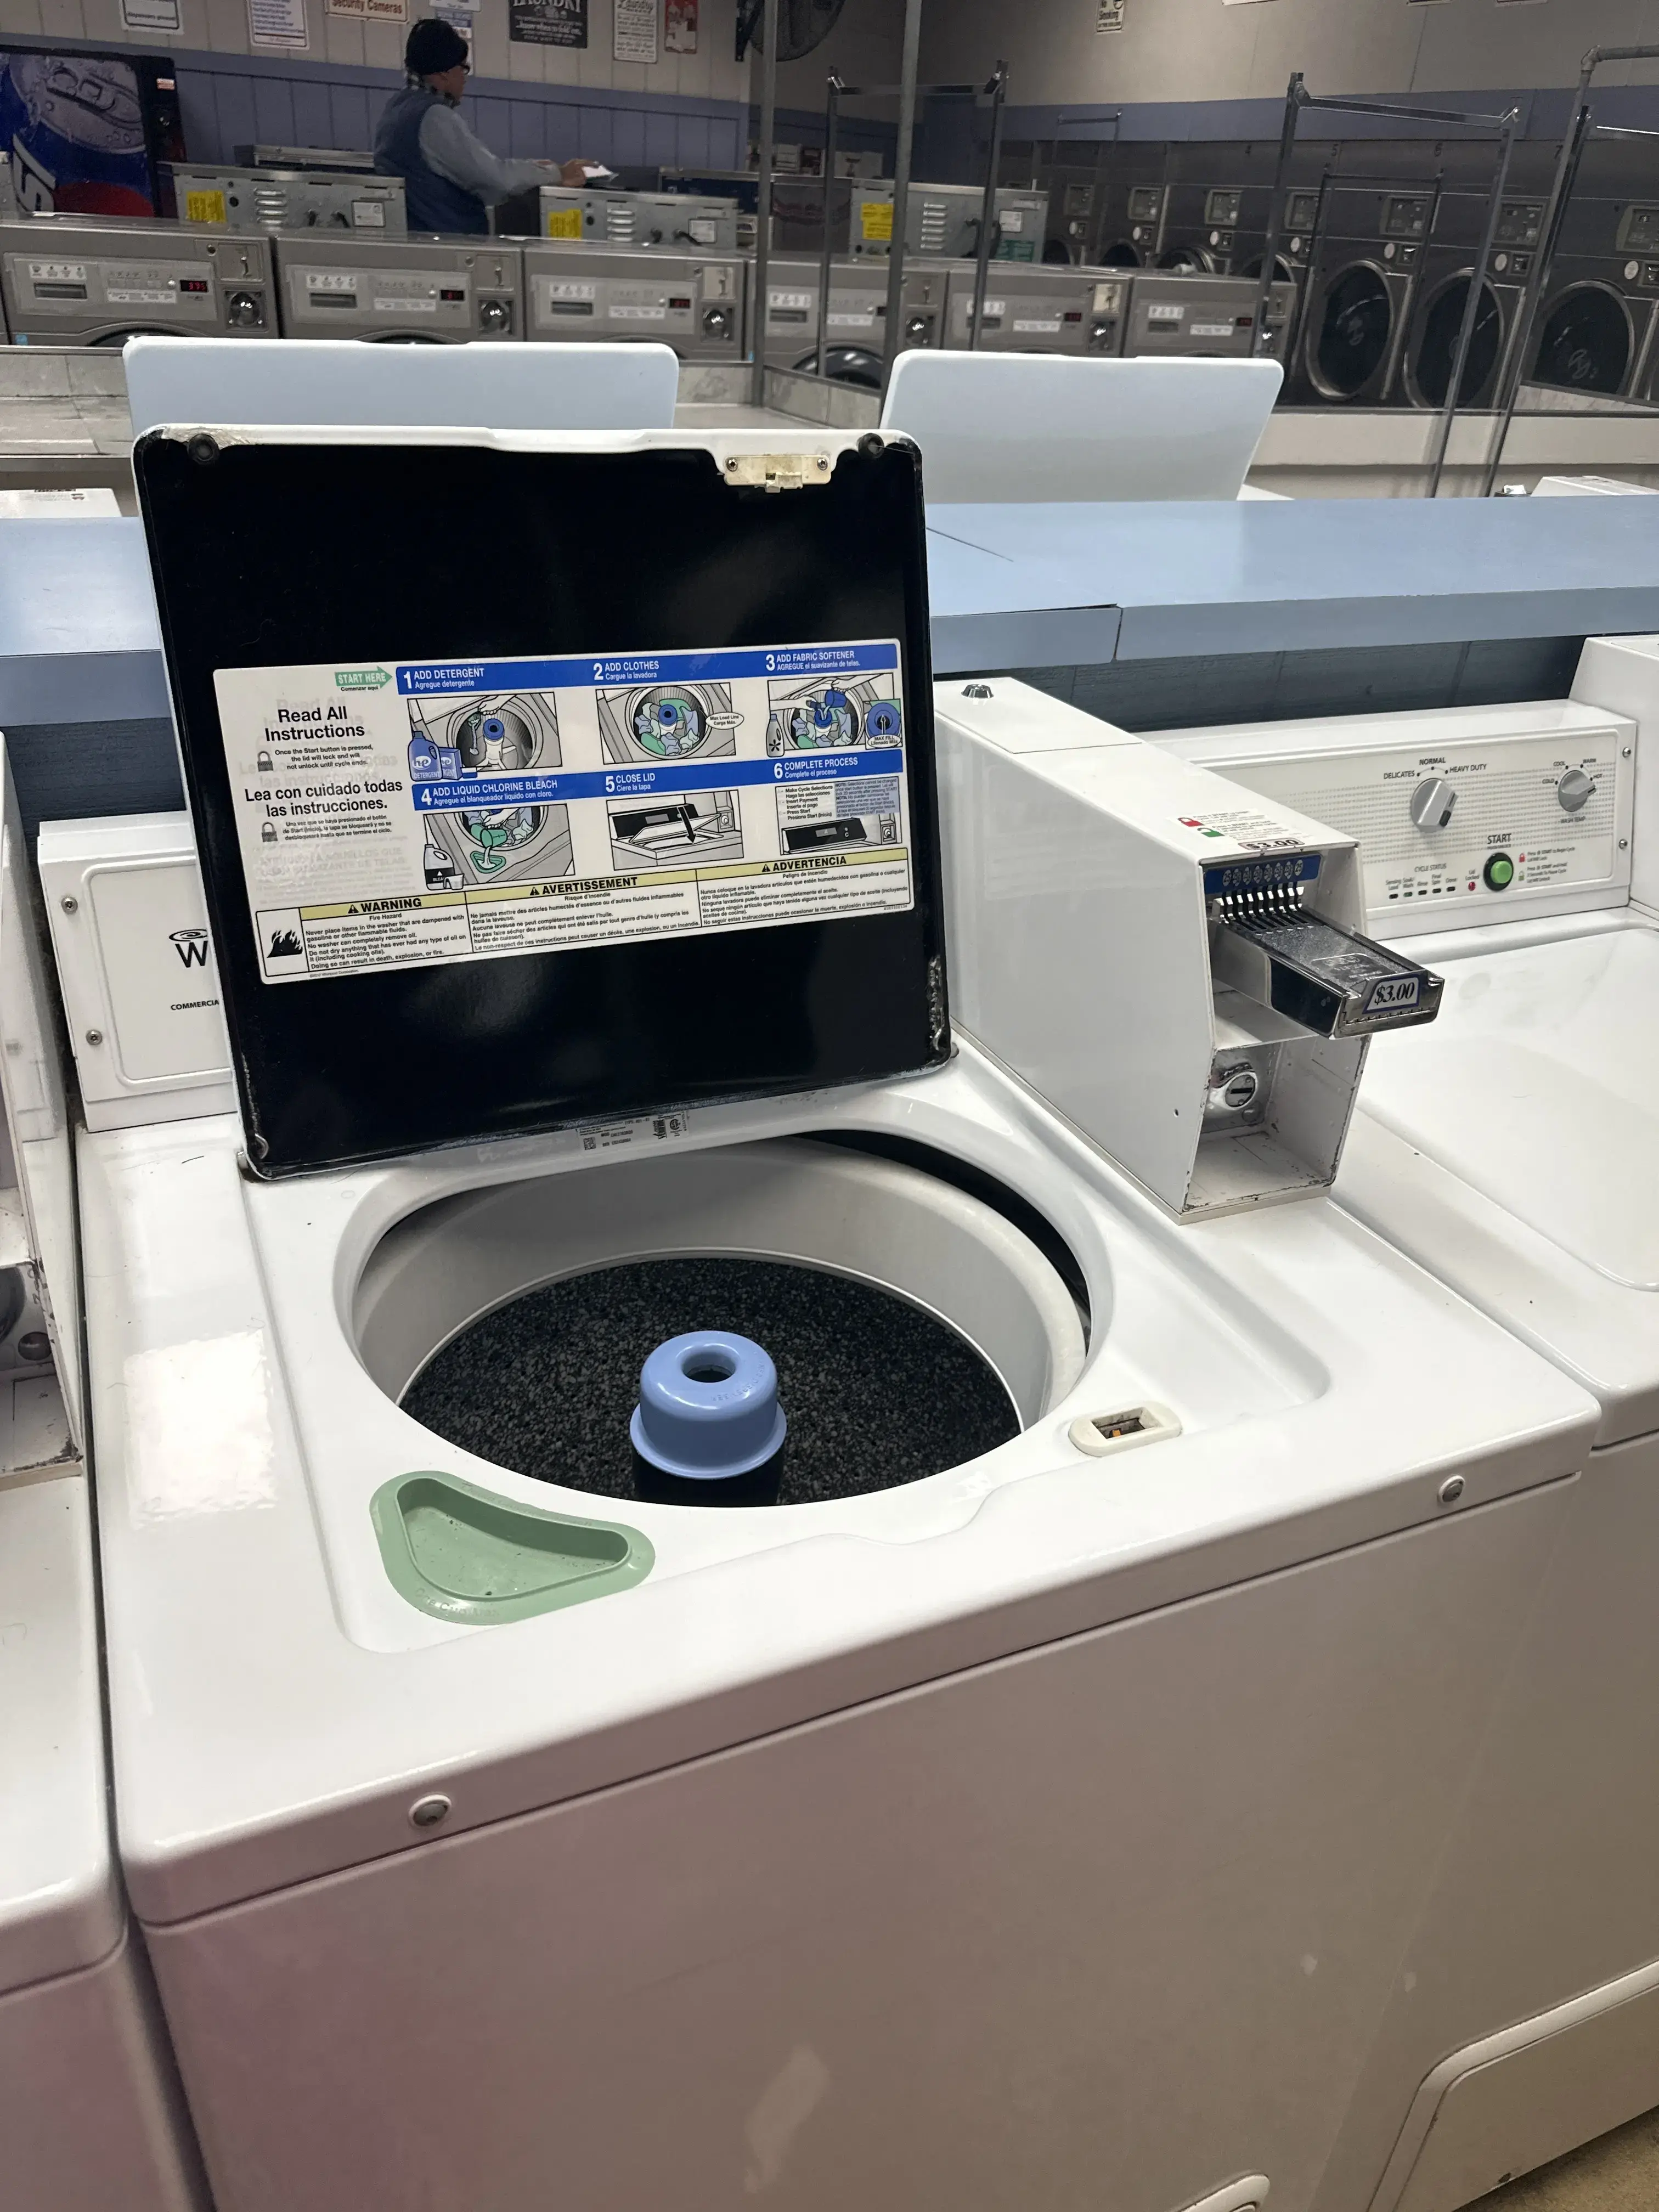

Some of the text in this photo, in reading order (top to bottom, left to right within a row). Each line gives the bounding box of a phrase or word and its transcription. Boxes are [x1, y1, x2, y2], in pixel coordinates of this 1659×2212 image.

[766, 654, 775, 671] 3
[793, 653, 817, 661] FABRIC
[819, 651, 854, 660] SOFTENER
[338, 673, 386, 684] START HERE
[404, 668, 484, 689] 1 ADD DETERGENT
[594, 661, 659, 680] 2 ADD CLOTHES
[278, 706, 347, 723] Read All
[265, 725, 364, 741] Instructions
[774, 757, 858, 778] 6 COMPLETE PROCESS
[1384, 770, 1415, 779] DELICATES
[245, 780, 402, 802] Lea con cuidado todas
[606, 773, 655, 793] 5 CLOSE LID
[421, 780, 557, 806] 4 ADD LIQUID CHLORINE BLEACH
[467, 794, 503, 803] blanqueador
[266, 799, 387, 817] las instrucciones.
[1246, 839, 1299, 849] $3.00
[1487, 833, 1511, 844] START
[773, 856, 847, 871] ADVERTENCIA
[542, 877, 637, 895] AVERTISSEMENT
[360, 898, 421, 912] WARNING
[1374, 982, 1414, 1005] $3.00
[171, 1000, 219, 1011] COMMERCIA
